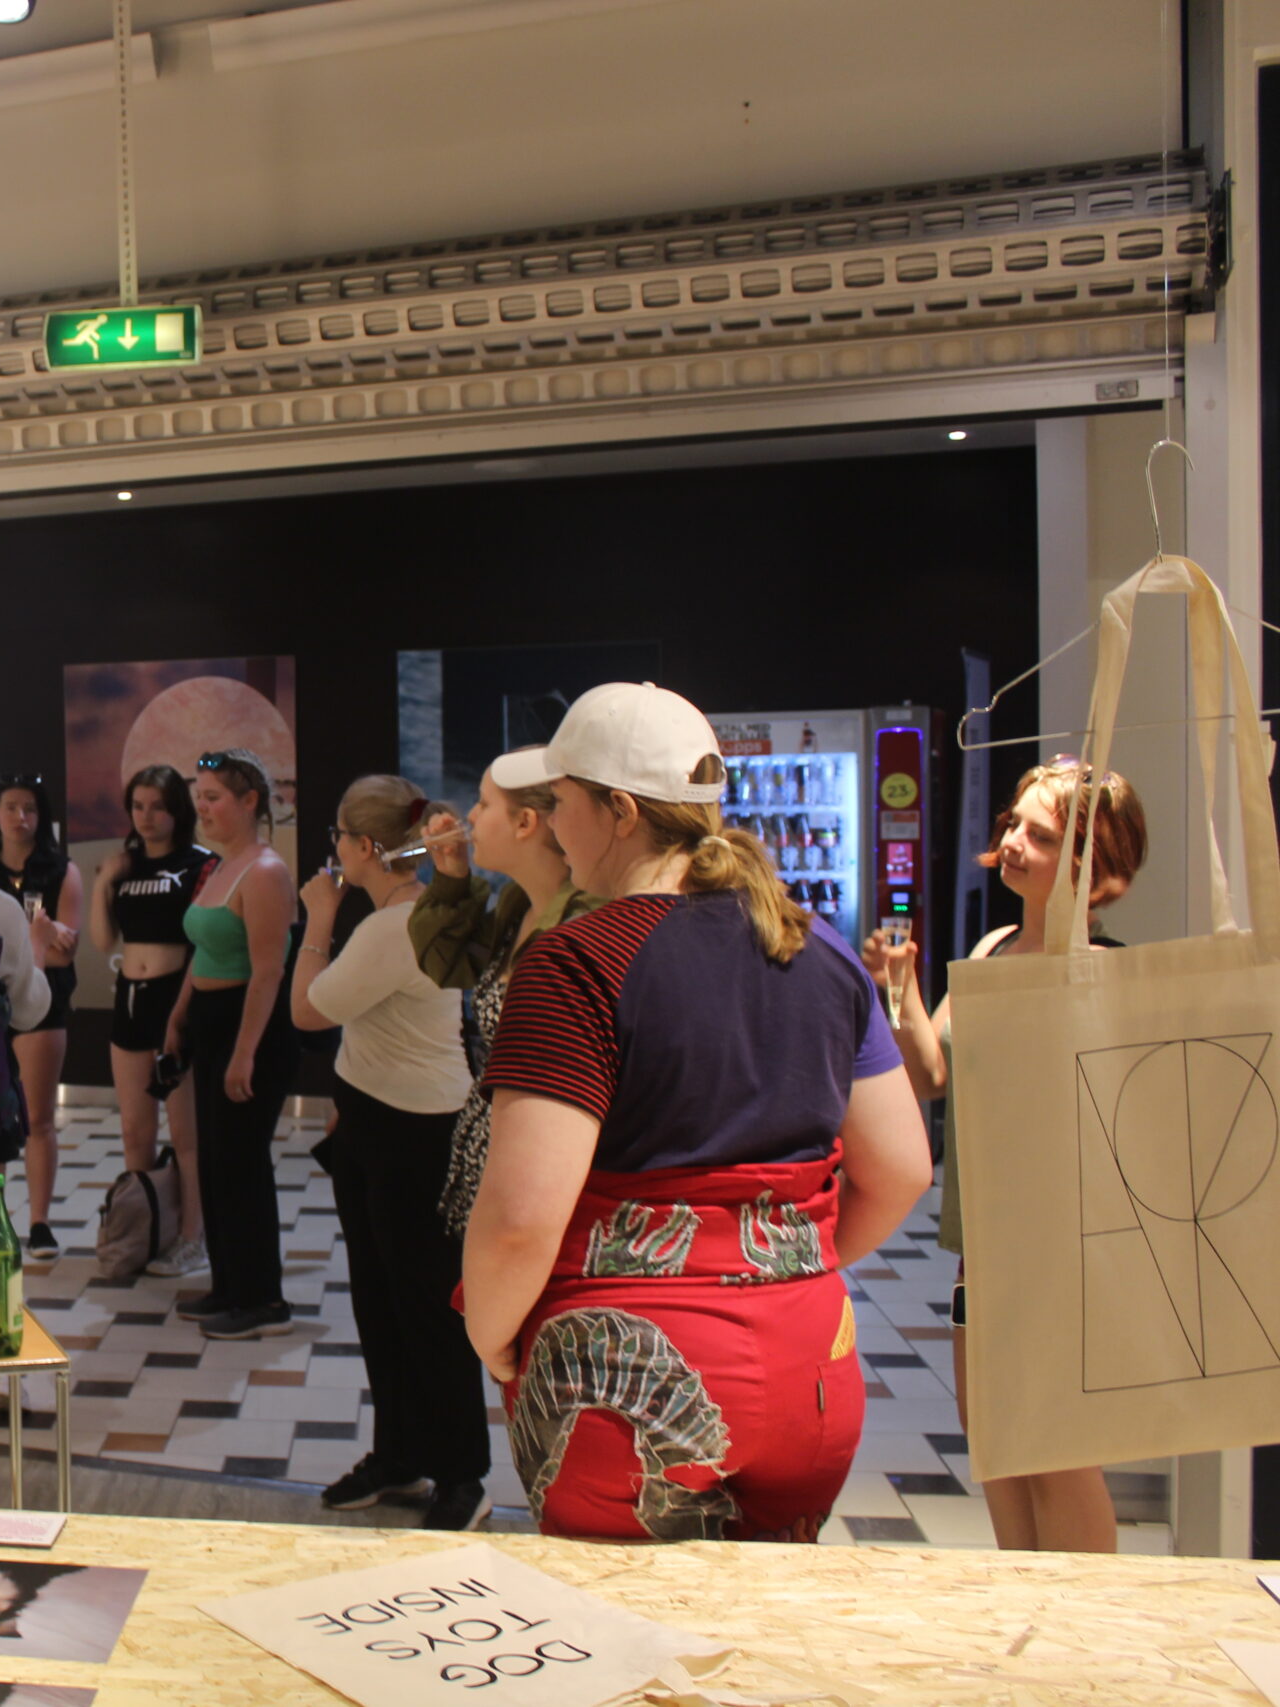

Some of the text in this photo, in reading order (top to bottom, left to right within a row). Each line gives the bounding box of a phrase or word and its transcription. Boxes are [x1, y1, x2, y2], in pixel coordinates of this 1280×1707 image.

[119, 878, 171, 897] PUMA
[296, 1577, 501, 1637] INSIDE
[365, 1609, 551, 1660] TOYS
[440, 1639, 593, 1689] DOG
